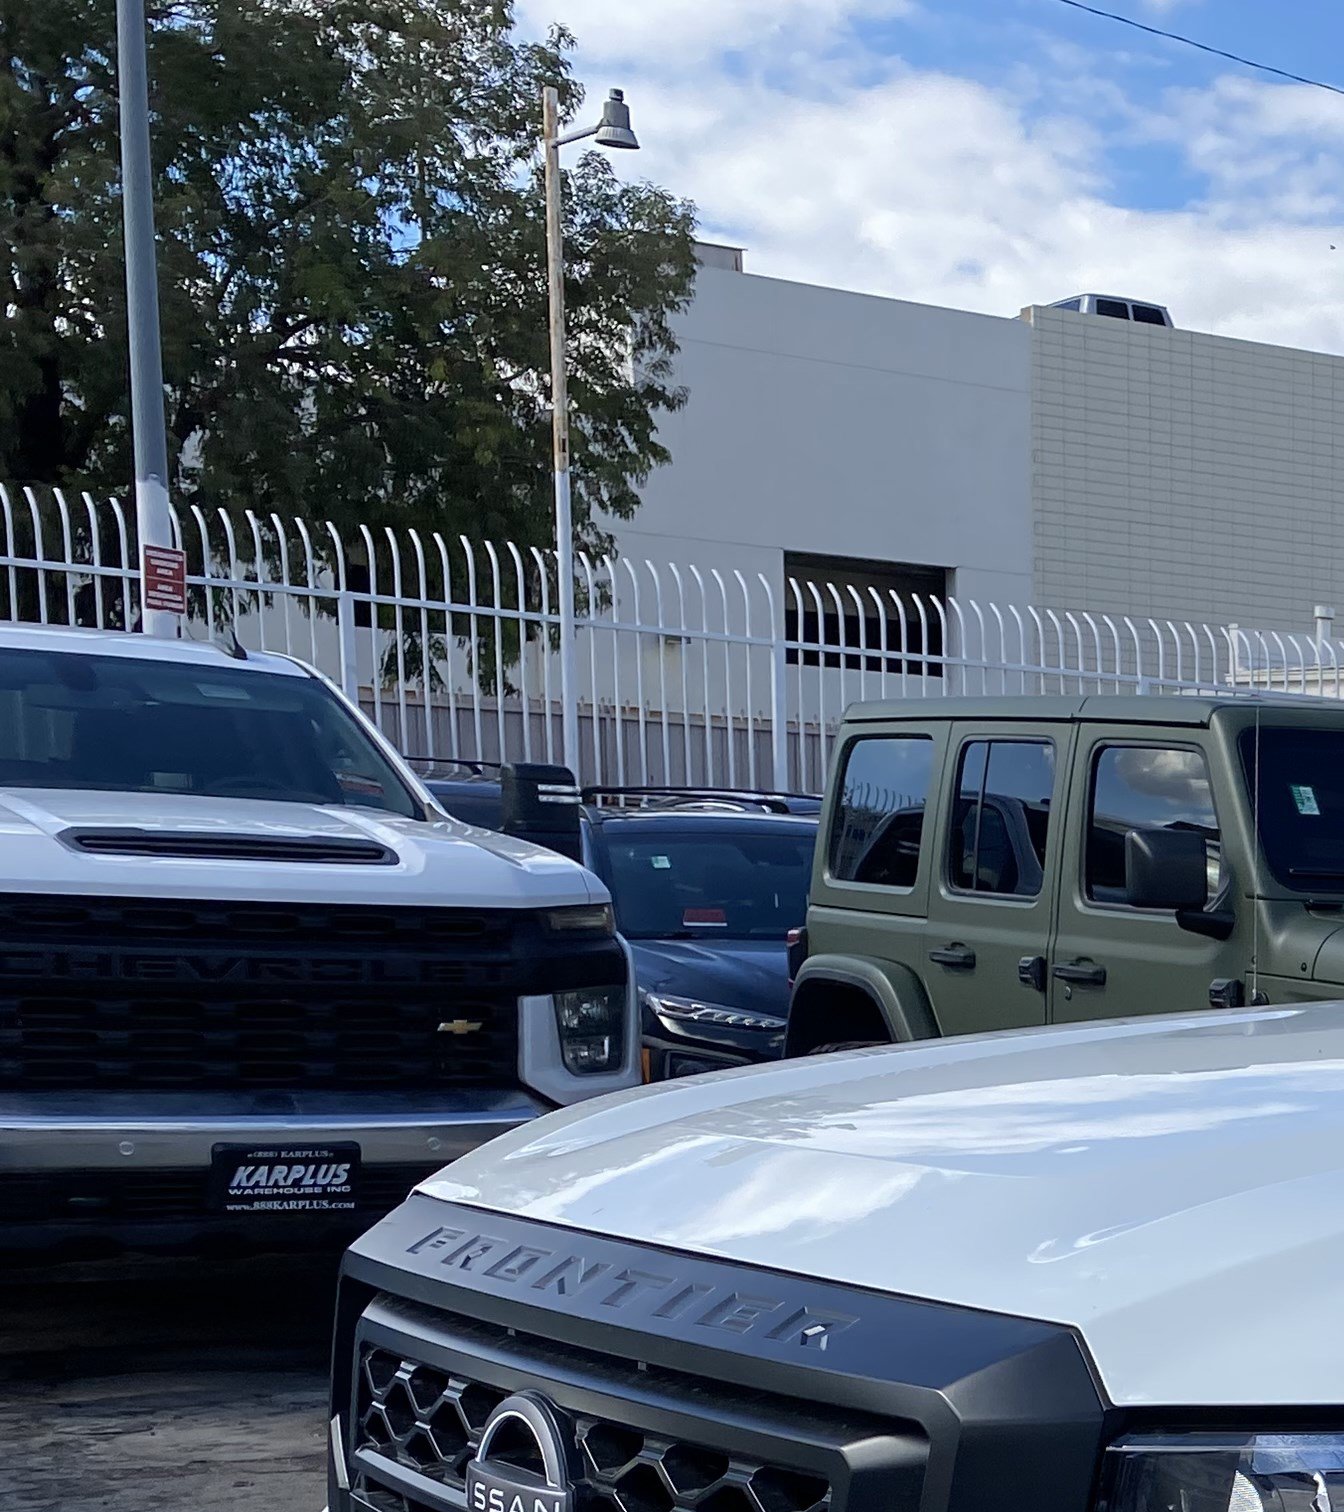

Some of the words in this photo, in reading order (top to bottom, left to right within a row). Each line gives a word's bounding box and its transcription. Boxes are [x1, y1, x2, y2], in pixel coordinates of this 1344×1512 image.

[281, 1150, 329, 1158] KARPLUS
[229, 1163, 351, 1187] KARPLUS
[228, 1187, 323, 1195] WAREHOUSE
[406, 1226, 861, 1353] FRONTIER
